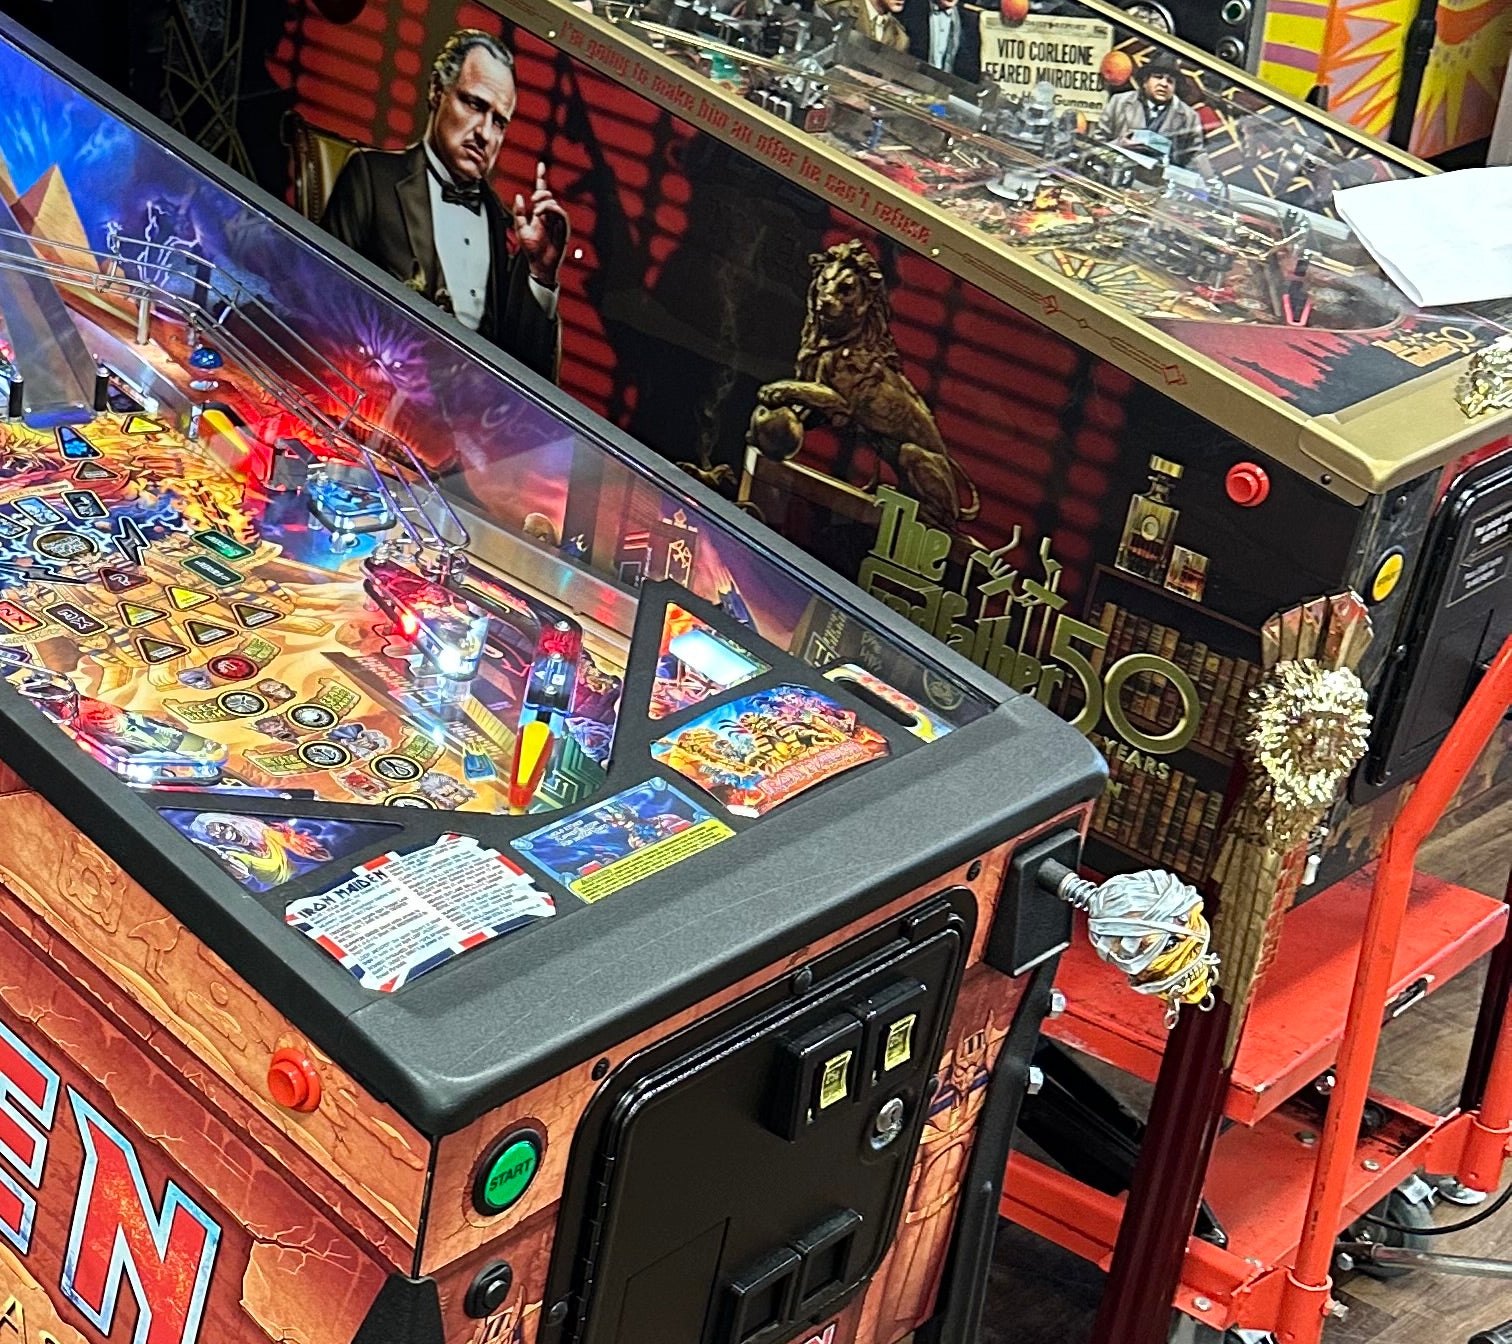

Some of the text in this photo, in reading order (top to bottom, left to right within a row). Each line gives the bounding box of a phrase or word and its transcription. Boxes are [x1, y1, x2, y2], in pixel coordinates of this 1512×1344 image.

[997, 38, 1094, 67] VITO CORLEONE
[651, 74, 695, 111] make
[985, 62, 1105, 92] FEARED MURDERED
[1052, 94, 1103, 110] Gunmen
[868, 484, 952, 581] The
[1050, 613, 1202, 755] 50
[1103, 739, 1171, 781] YEARS
[296, 868, 388, 919] IRON MAIDEN
[488, 1159, 533, 1192] START
